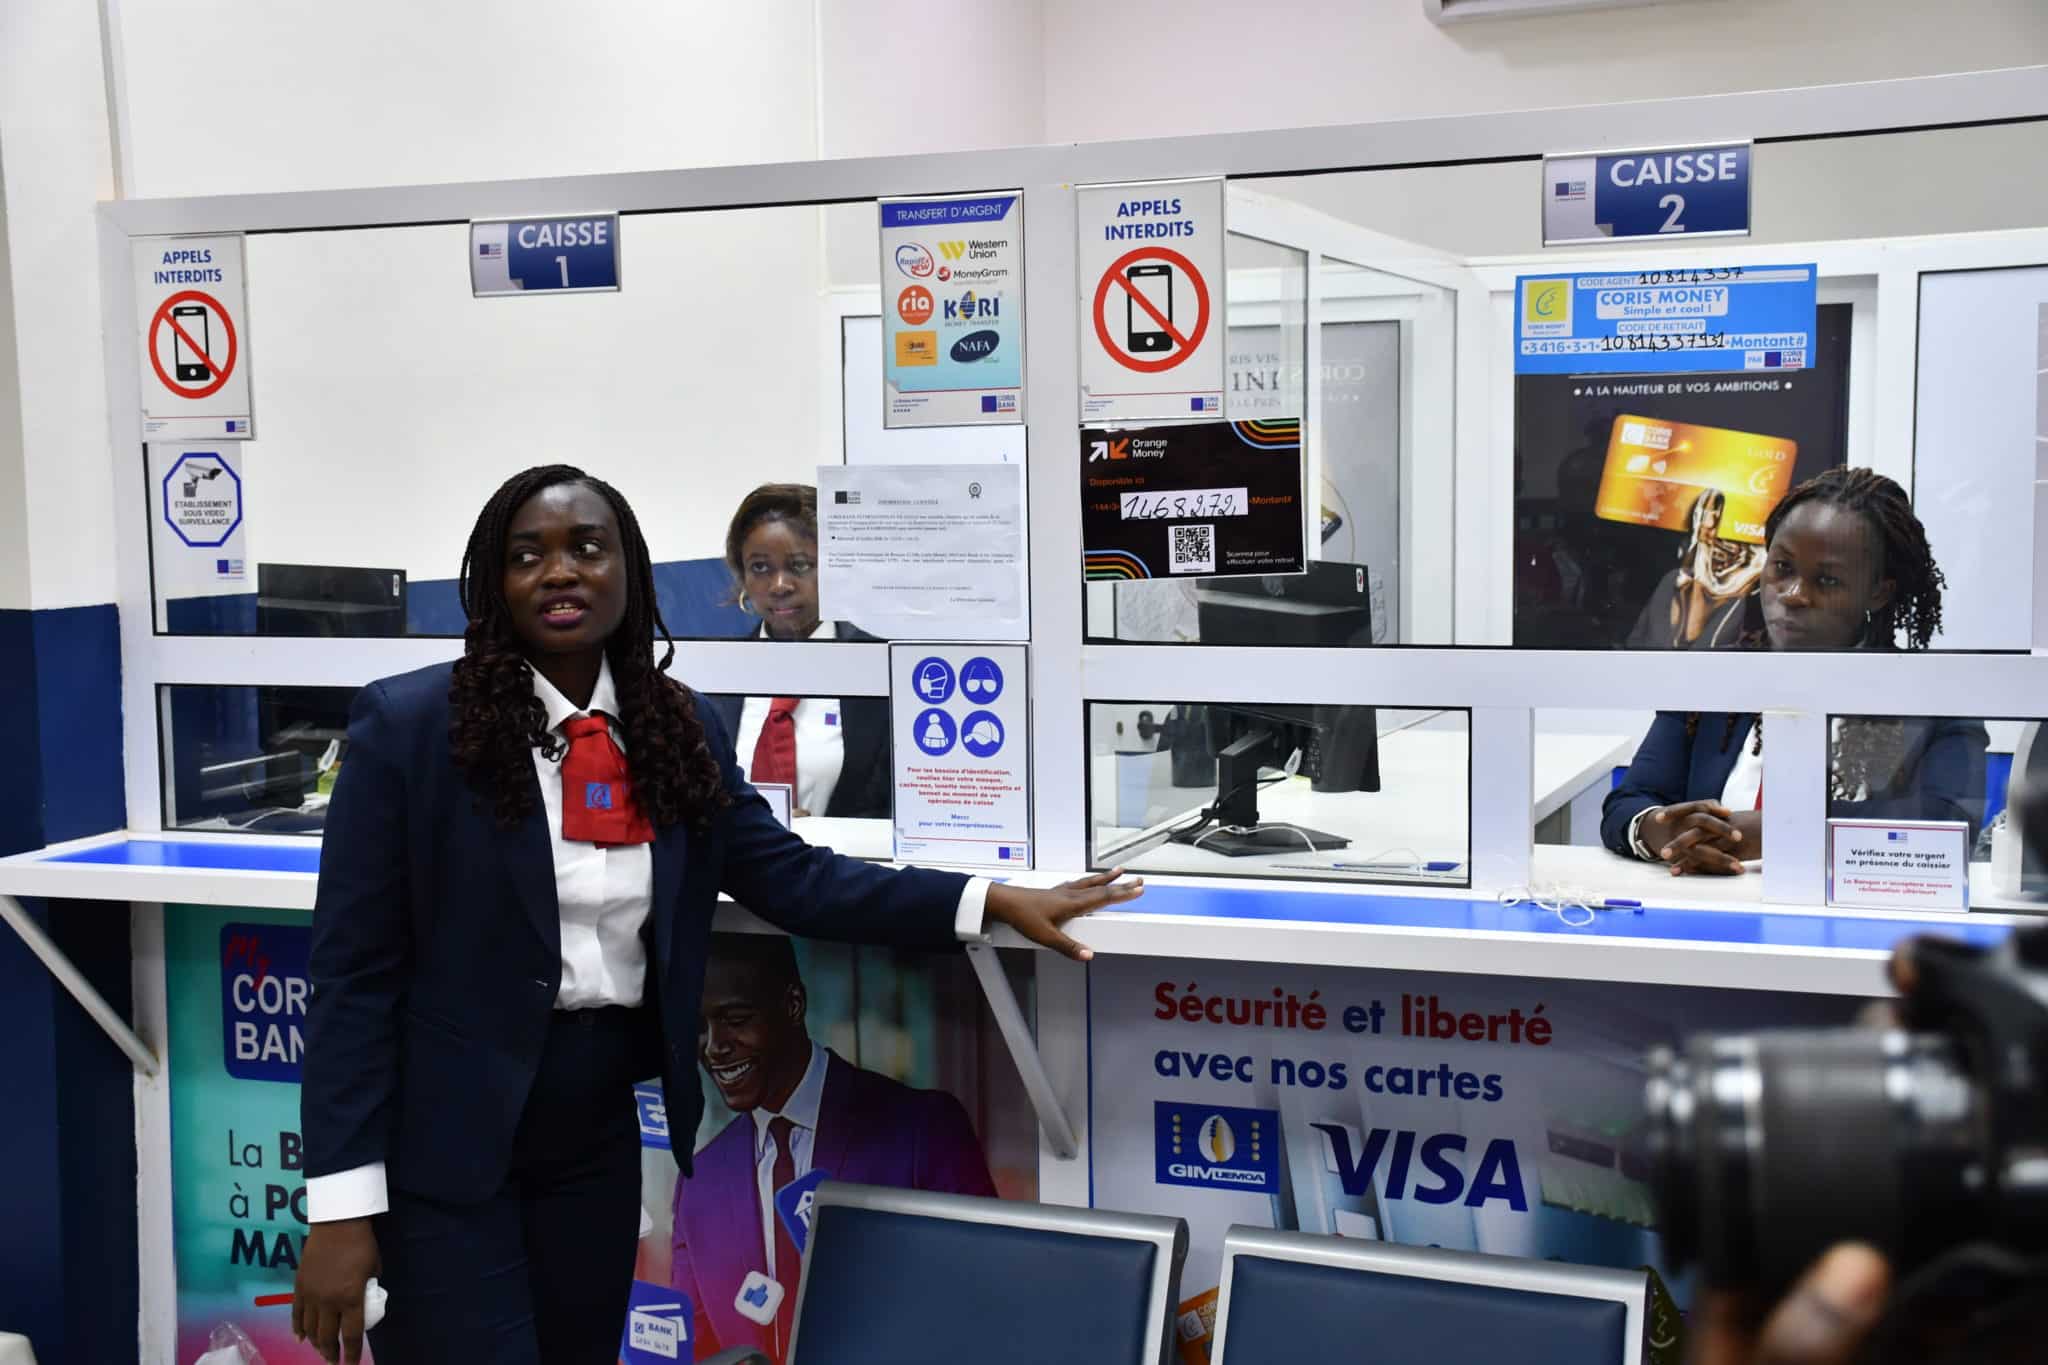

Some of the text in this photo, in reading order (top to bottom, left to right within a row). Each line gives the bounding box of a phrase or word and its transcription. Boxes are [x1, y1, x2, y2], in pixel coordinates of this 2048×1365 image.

[1610, 152, 1737, 187] CAISSE
[897, 204, 1002, 221] TRANSFERT D'ARGENT
[1116, 199, 1182, 218] APPELS
[1658, 194, 1685, 233] 2
[517, 219, 607, 249] CAISSE
[1104, 220, 1194, 241] INTERDITS
[969, 240, 1007, 249] Western
[162, 249, 212, 265] APPELS
[969, 249, 997, 259] Union
[154, 268, 222, 285] INTERDITS
[556, 255, 569, 287] 1
[953, 268, 1008, 280] MoneyGram
[1640, 267, 1744, 285] 10814337
[1580, 277, 1636, 287] CODE AGENT
[902, 290, 930, 311] ria
[1601, 288, 1725, 305] CORIS MONEY
[944, 291, 999, 320] KORI
[1623, 304, 1661, 316] Simple
[1665, 305, 1676, 313] et
[1680, 303, 1704, 313] cool
[1619, 321, 1704, 332] CODE DE RETRAIT
[960, 341, 991, 352] NAFA
[1585, 381, 1779, 396] A LA HAUTEUR DE VOS AMBITIONS
[1132, 439, 1168, 449] Orange
[1132, 449, 1165, 459] Money
[174, 500, 232, 509] ETABLISSEMENT
[204, 509, 225, 517] VIDEO
[178, 518, 230, 526] SURVEILLANCE
[1734, 521, 1766, 537] VISA
[1851, 848, 1945, 861] Vérifiez votre argent
[1859, 859, 1899, 869] présence
[1902, 860, 1914, 868] du
[1916, 861, 1951, 869] caissier
[233, 974, 315, 1016] COR
[1155, 982, 1552, 1045] Sécurité et liberté
[1154, 1048, 1504, 1102] avec nos cartes
[229, 1129, 262, 1168] La
[1310, 1122, 1529, 1212] VISA
[230, 1182, 249, 1218] à
[648, 1323, 672, 1337] BANK
